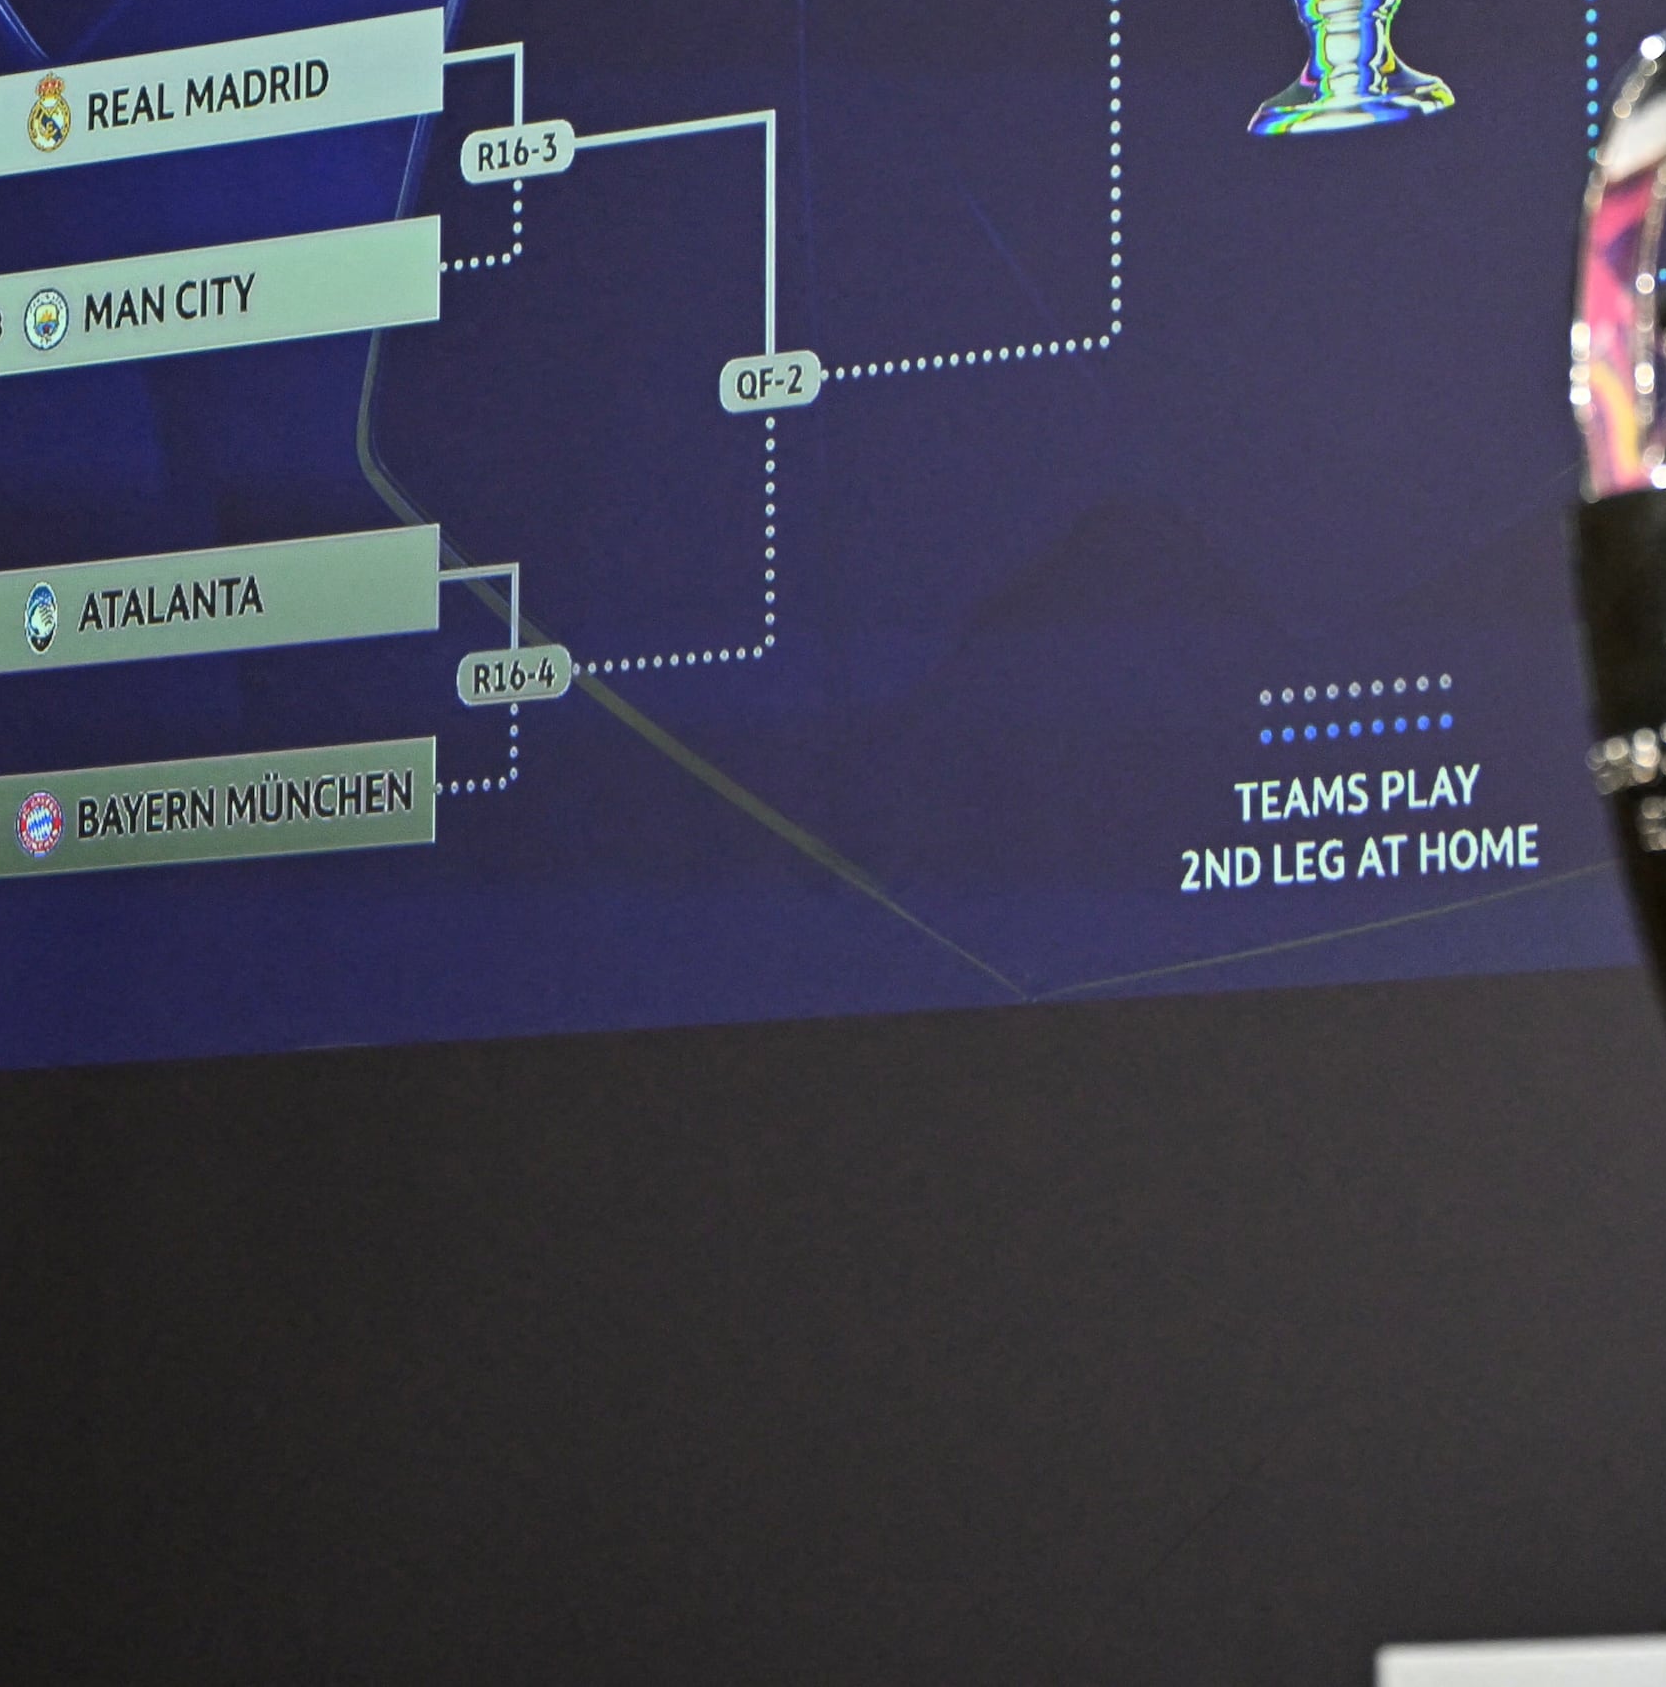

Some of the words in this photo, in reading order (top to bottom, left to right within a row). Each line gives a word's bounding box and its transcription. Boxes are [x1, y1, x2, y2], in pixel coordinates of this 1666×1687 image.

[88, 83, 175, 131] REAL
[185, 59, 329, 117] MADRID
[478, 132, 559, 173] R16-3
[84, 284, 165, 333] MAN
[175, 272, 255, 320] CITY
[736, 364, 803, 401] QF-2
[78, 575, 264, 632] ATALANTA
[474, 657, 555, 695] R16-4
[78, 788, 214, 839] BAYERN
[227, 770, 412, 826] MÜNCHEN
[1234, 772, 1369, 823] TEAMS
[1381, 763, 1480, 812] PLAY
[1180, 847, 1262, 893] 2ND
[1273, 838, 1345, 886] LEG
[1357, 834, 1408, 879] AT
[1419, 823, 1540, 875] HOME
